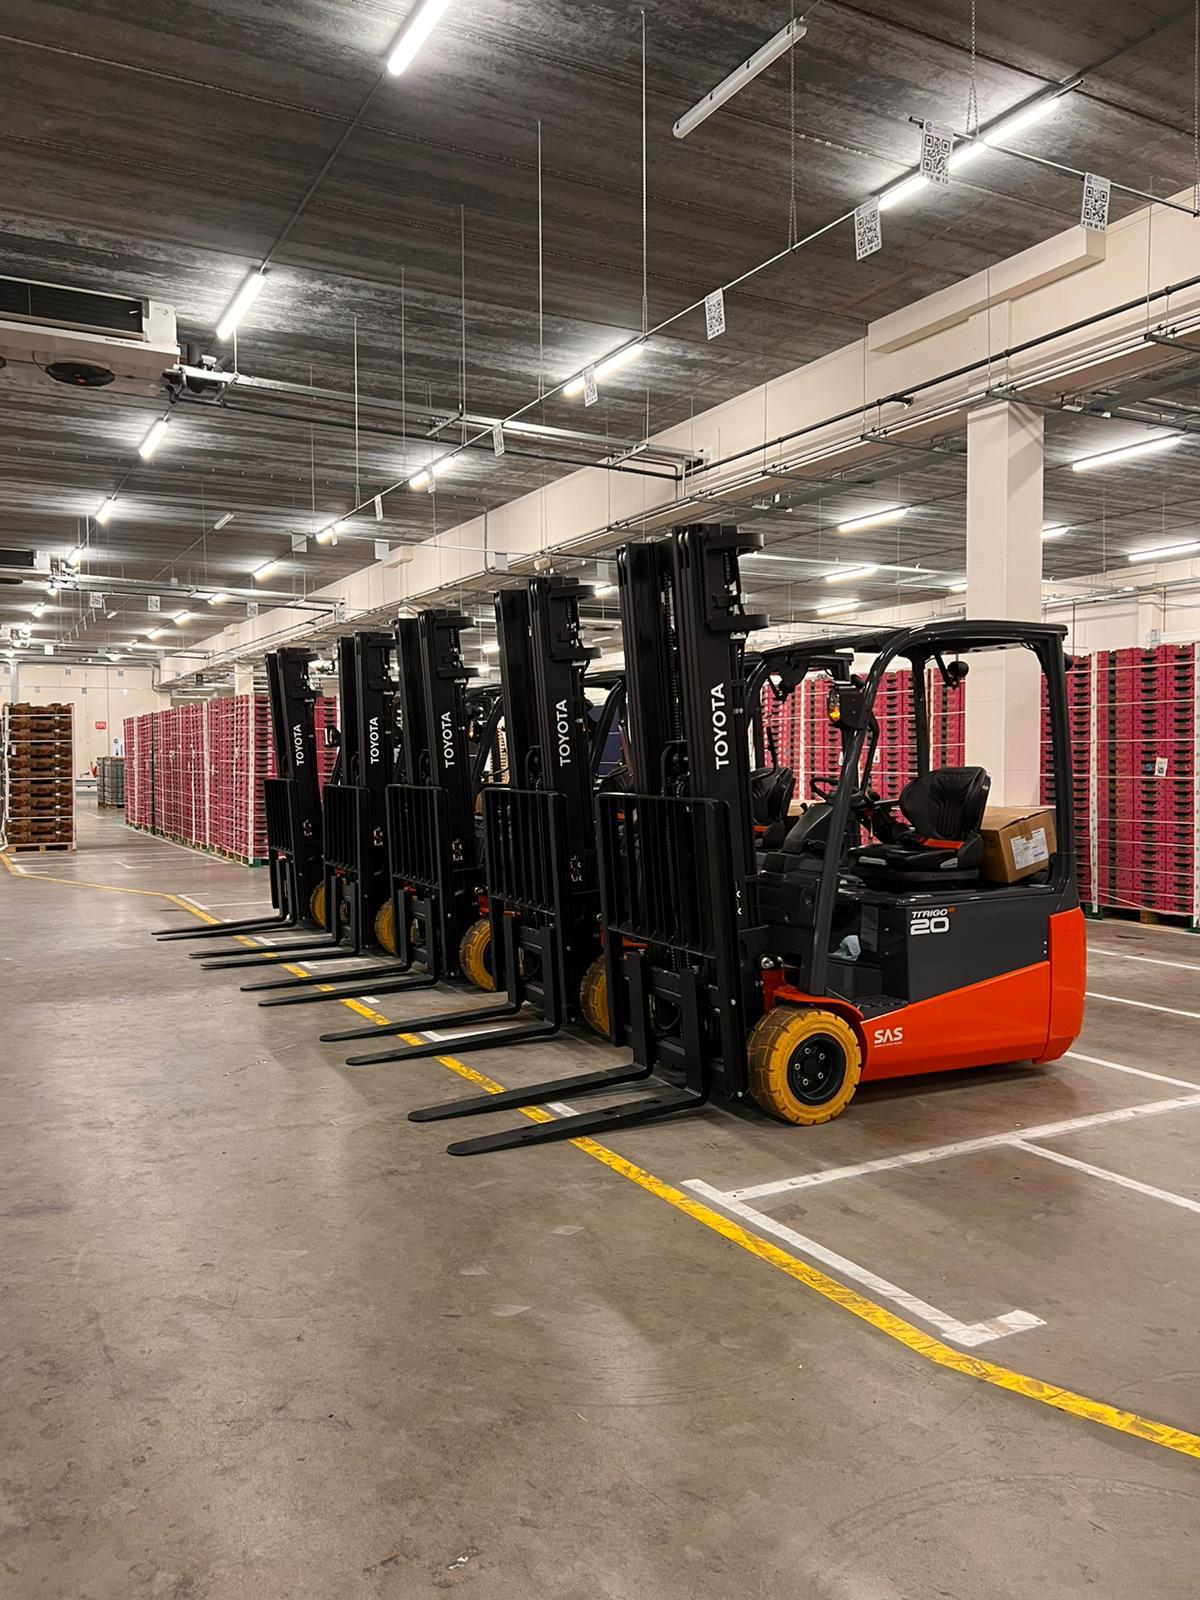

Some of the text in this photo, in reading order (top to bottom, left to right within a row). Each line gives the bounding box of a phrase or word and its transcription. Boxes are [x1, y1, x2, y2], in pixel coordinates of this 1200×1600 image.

[293, 723, 305, 766] TOYOTA
[369, 716, 379, 765] TOYOTA
[441, 711, 455, 768] TOYOTA
[556, 699, 571, 767] TOYOTA
[710, 682, 729, 770] TOYOTA
[910, 916, 950, 936] 20
[873, 1026, 904, 1045] SAS
